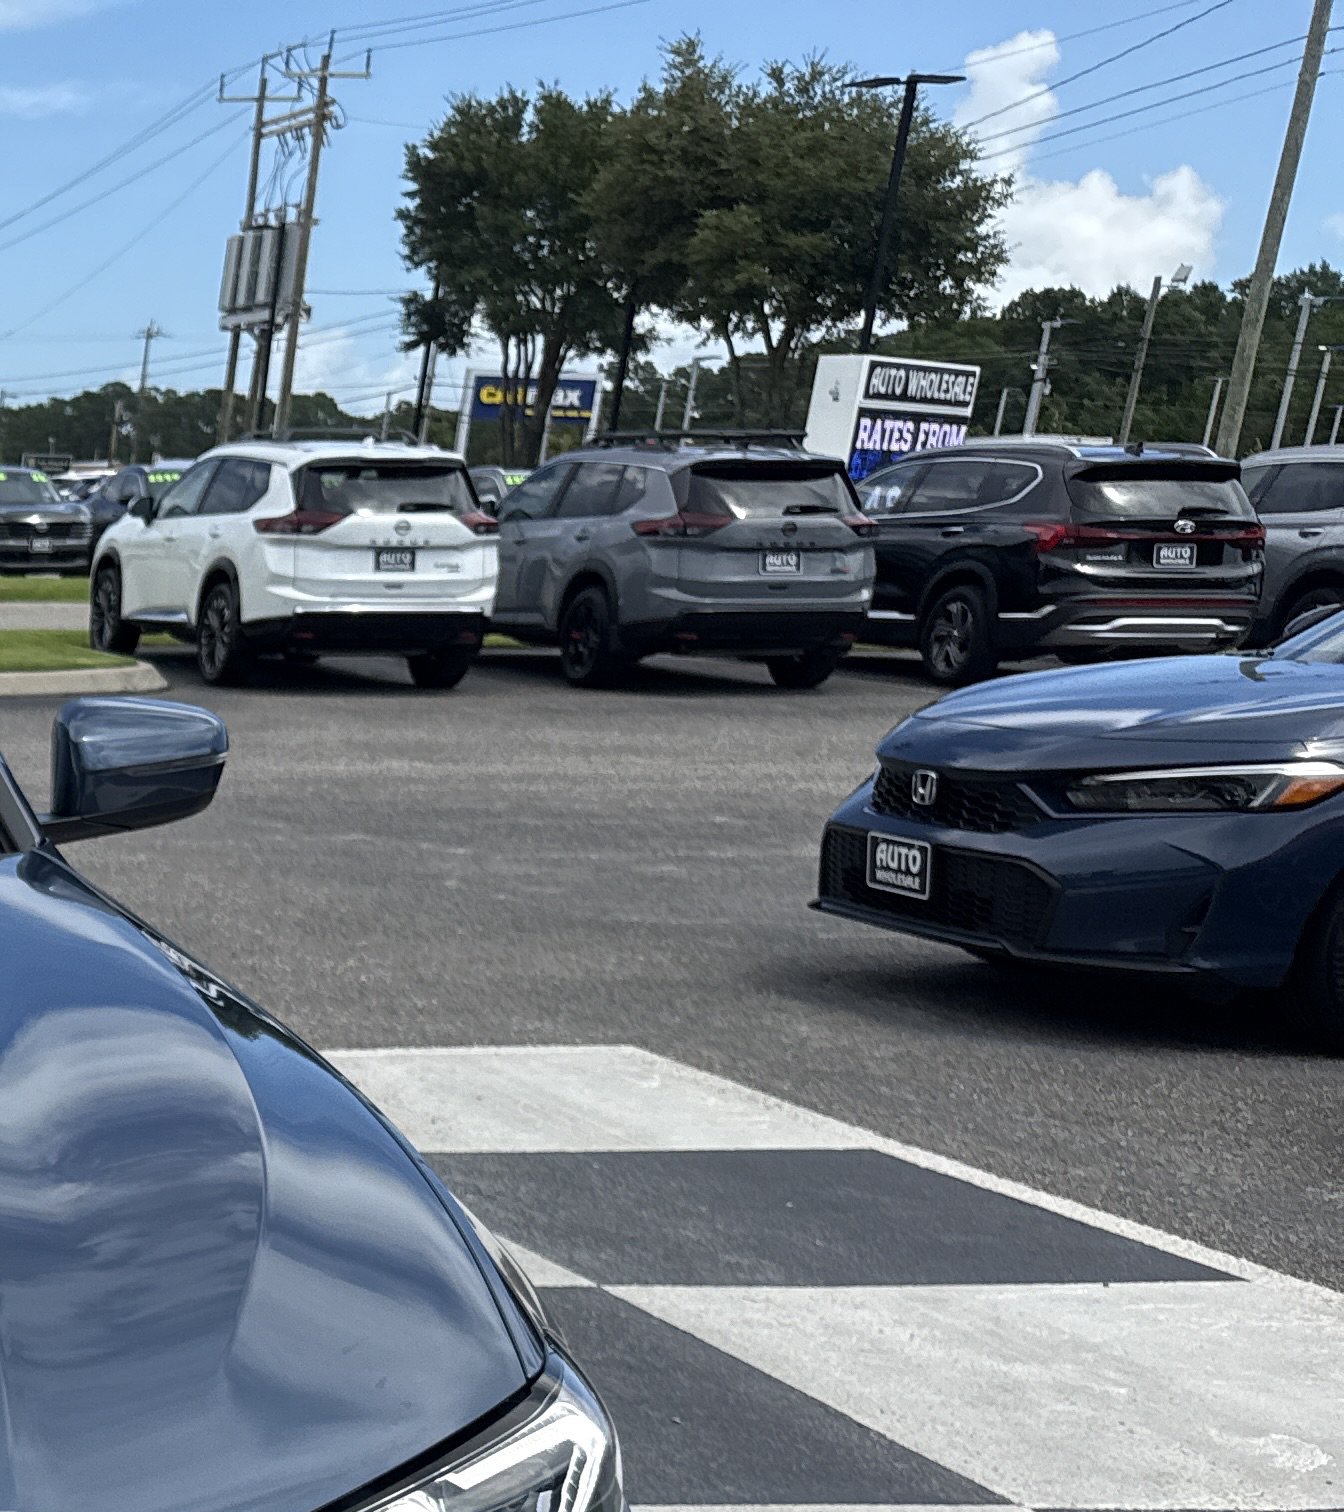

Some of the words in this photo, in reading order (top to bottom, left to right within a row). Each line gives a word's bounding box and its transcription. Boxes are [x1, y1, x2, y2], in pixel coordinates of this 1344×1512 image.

[869, 365, 907, 397] AUTO
[907, 369, 975, 403] WHOLESALE
[855, 416, 916, 453] RATES
[915, 420, 969, 453] FROM
[1160, 546, 1191, 559] AUTO
[875, 842, 922, 875] AUTO
